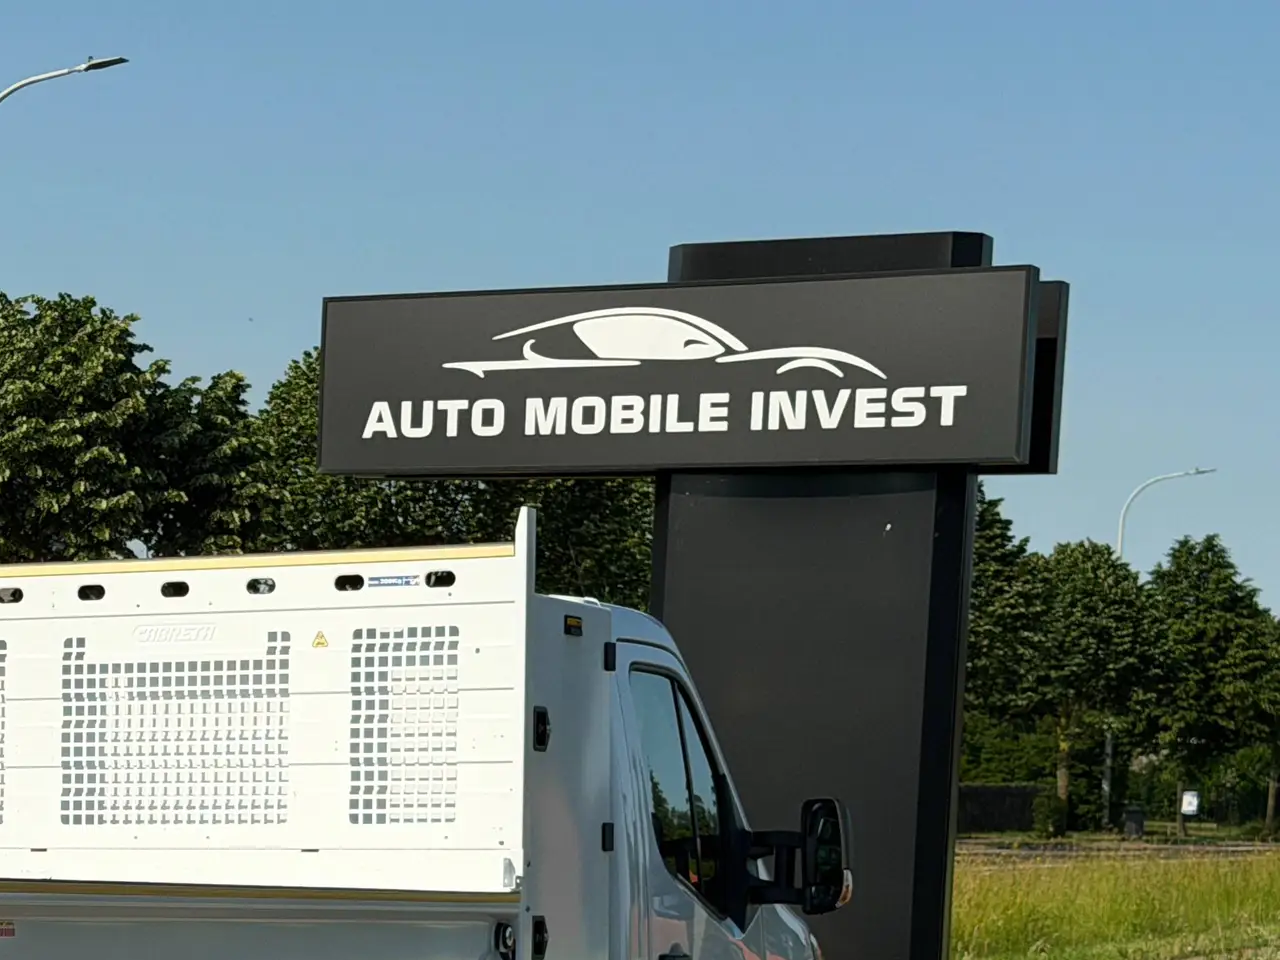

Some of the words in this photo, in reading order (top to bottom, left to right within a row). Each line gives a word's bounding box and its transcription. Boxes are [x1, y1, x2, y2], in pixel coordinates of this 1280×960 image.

[361, 396, 506, 439] AUTO
[523, 391, 731, 436] MOBILE
[749, 384, 969, 432] INVEST
